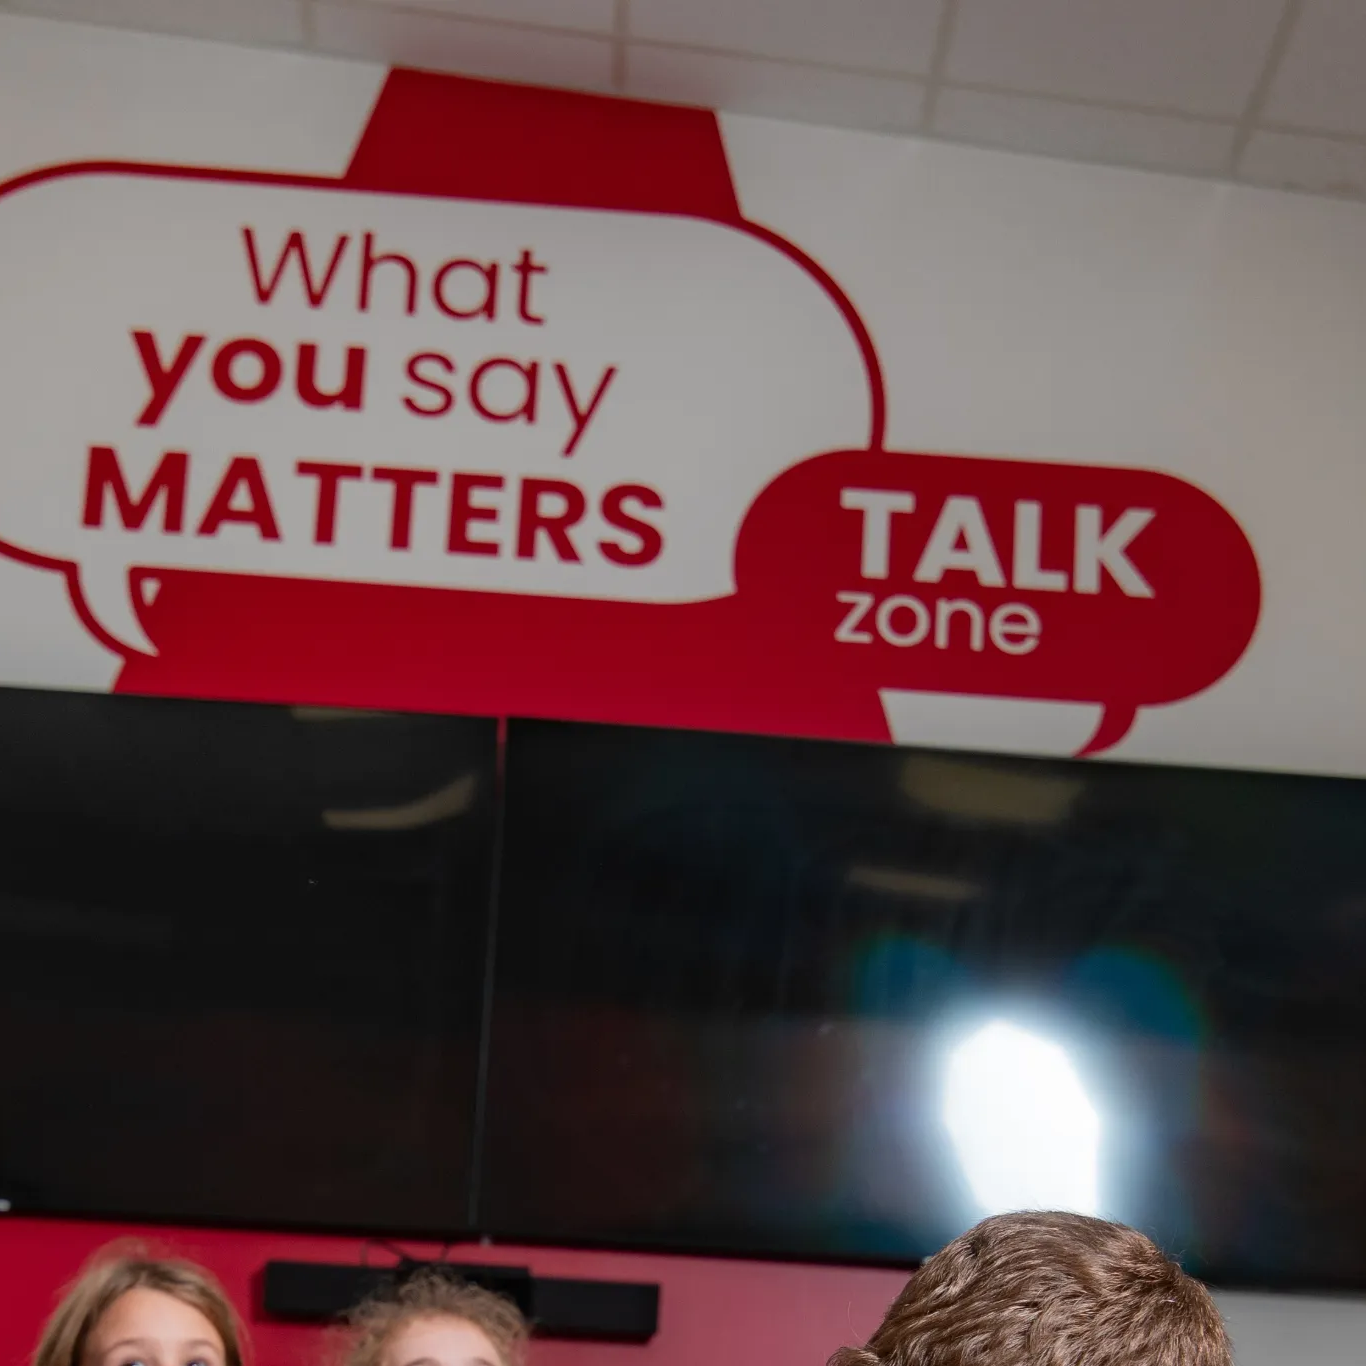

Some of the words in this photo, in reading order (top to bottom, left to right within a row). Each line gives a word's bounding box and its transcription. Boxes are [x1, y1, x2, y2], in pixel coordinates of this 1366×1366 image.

[241, 226, 547, 326] What
[130, 328, 369, 429] you
[402, 350, 617, 458] say
[81, 444, 665, 569] MATTERS
[839, 487, 1156, 599] TALK
[834, 591, 1042, 655] zone
